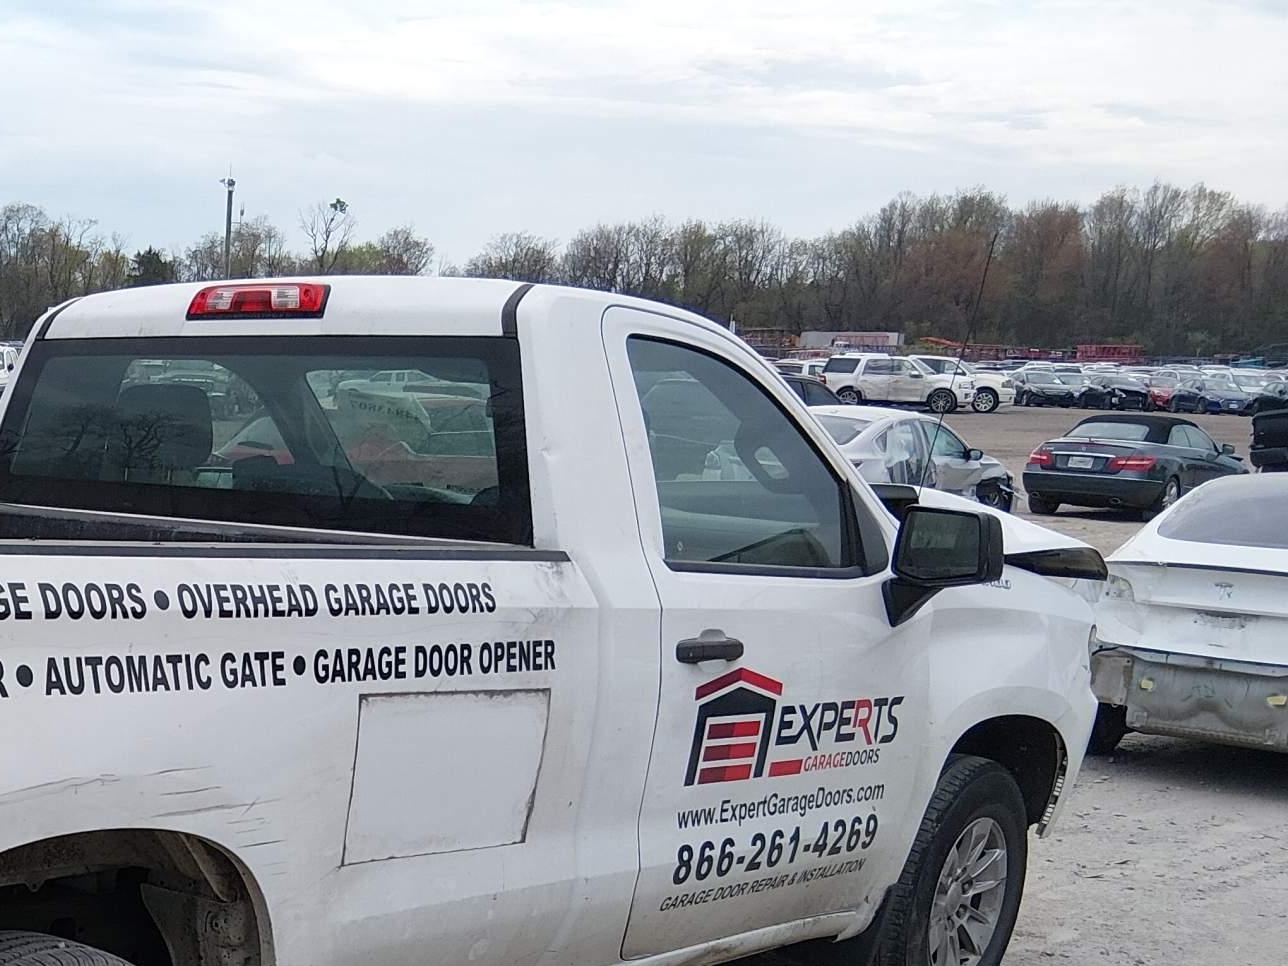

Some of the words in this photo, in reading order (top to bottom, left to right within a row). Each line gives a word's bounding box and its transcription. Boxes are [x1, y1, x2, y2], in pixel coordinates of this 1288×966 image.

[37, 582, 147, 620] DOORS
[176, 583, 318, 619] OVERHEAD
[324, 583, 419, 617] GARAGE
[421, 582, 496, 614] DOORS
[44, 653, 213, 695] AUTOMATIC
[220, 651, 286, 688] GATE
[313, 645, 407, 685] GARAGE
[414, 643, 473, 679] DOOR
[479, 639, 556, 675] OPENER
[775, 696, 904, 751] EXPERTS
[804, 748, 880, 772] GARAGEDOORS
[677, 784, 885, 829] www.ExpertGarageDoors.com
[673, 813, 879, 886] 866-261-4269
[660, 888, 714, 912] GARAGE
[712, 882, 748, 901] DOOR
[748, 874, 788, 894] REPAIR
[787, 874, 797, 887] &
[796, 858, 867, 884] INSTALLATION
